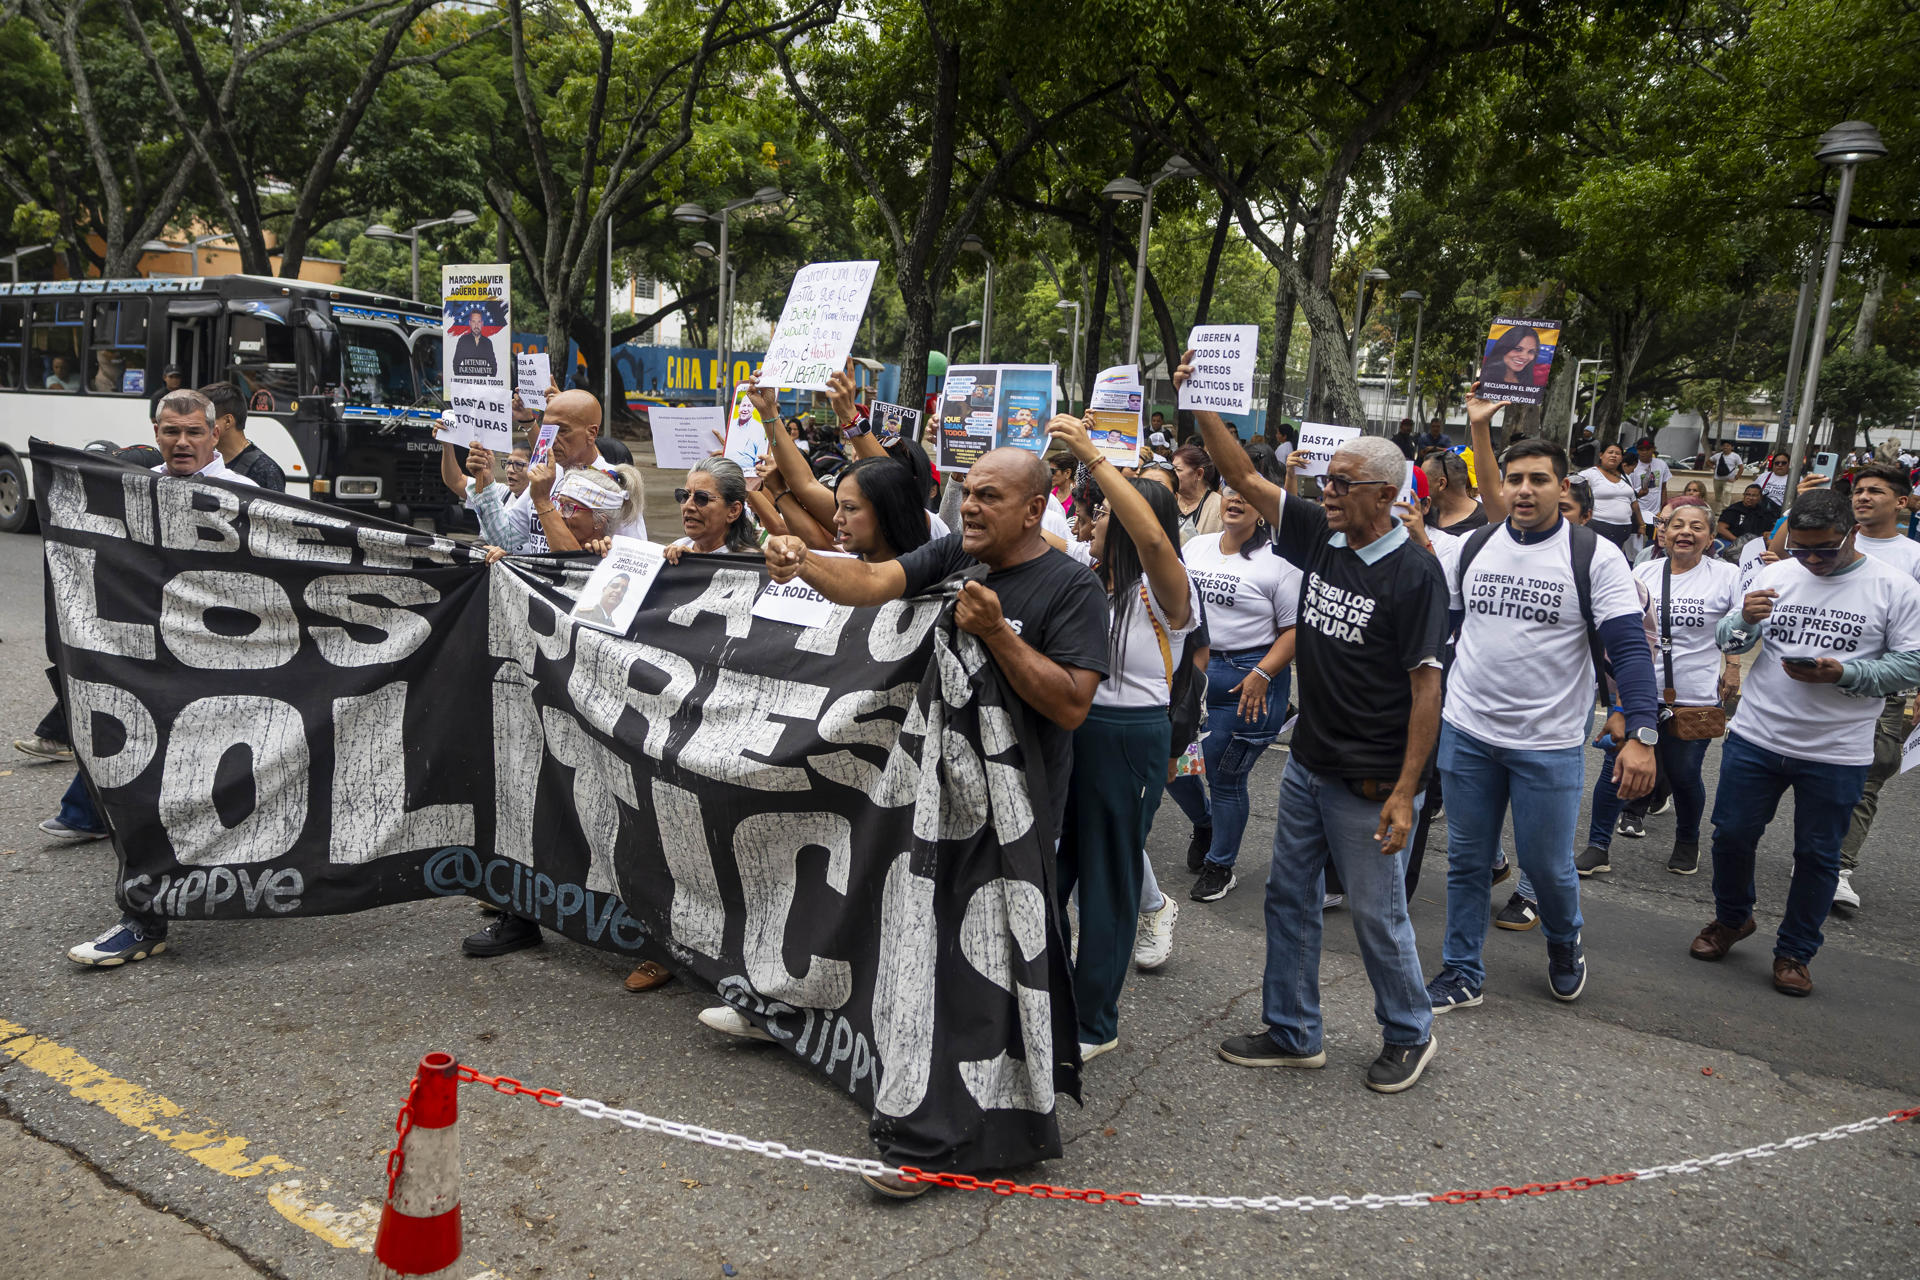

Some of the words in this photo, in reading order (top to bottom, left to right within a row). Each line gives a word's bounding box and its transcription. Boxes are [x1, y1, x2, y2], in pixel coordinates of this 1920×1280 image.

[449, 275, 476, 284] MARCOS
[478, 275, 504, 284] JAVIER
[450, 285, 477, 296] AGÜERO
[478, 287, 503, 296] BRAVO
[1532, 321, 1555, 329] BENITEZ
[1197, 333, 1232, 342] LIBEREN
[1233, 333, 1240, 342] A
[1194, 349, 1220, 358] TODOS
[1222, 349, 1240, 359] LOS
[464, 358, 487, 366] DETENIDO
[459, 365, 493, 375] INJUSTAMENTE
[1198, 364, 1231, 375] PRESOS
[473, 378, 486, 386] PARA
[1186, 379, 1231, 391] POLITICOS
[1232, 382, 1244, 392] DE
[1483, 382, 1509, 390] RECLUIDA
[1190, 395, 1202, 404] LA
[1204, 395, 1243, 408] YAGUARA
[1483, 392, 1501, 400] DESDE
[453, 397, 486, 411] BASTA
[489, 402, 505, 414] DE
[875, 402, 916, 419] LIBERTAD
[1302, 434, 1334, 446] BASTA
[612, 563, 648, 576] CARDENAS
[617, 557, 649, 569] JHOLMAR
[1215, 573, 1241, 584] TODOS
[1474, 573, 1515, 585] LIBEREN
[1517, 577, 1525, 586] A
[1528, 578, 1565, 593] TODOS
[765, 584, 780, 597] EL
[1471, 583, 1497, 598] LOS
[1500, 586, 1562, 608] PRESOS
[45, 539, 441, 671] LOS
[1344, 591, 1376, 613] LOS
[1346, 608, 1371, 628] DE
[1469, 599, 1560, 625] POLÍTICOS
[1773, 604, 1818, 616] LIBEREN
[1819, 609, 1826, 617] A
[1830, 609, 1867, 624] TODOS
[1770, 614, 1797, 627] LOS
[1801, 617, 1863, 638] PRESOS
[1769, 627, 1859, 652] POLÍTICOS
